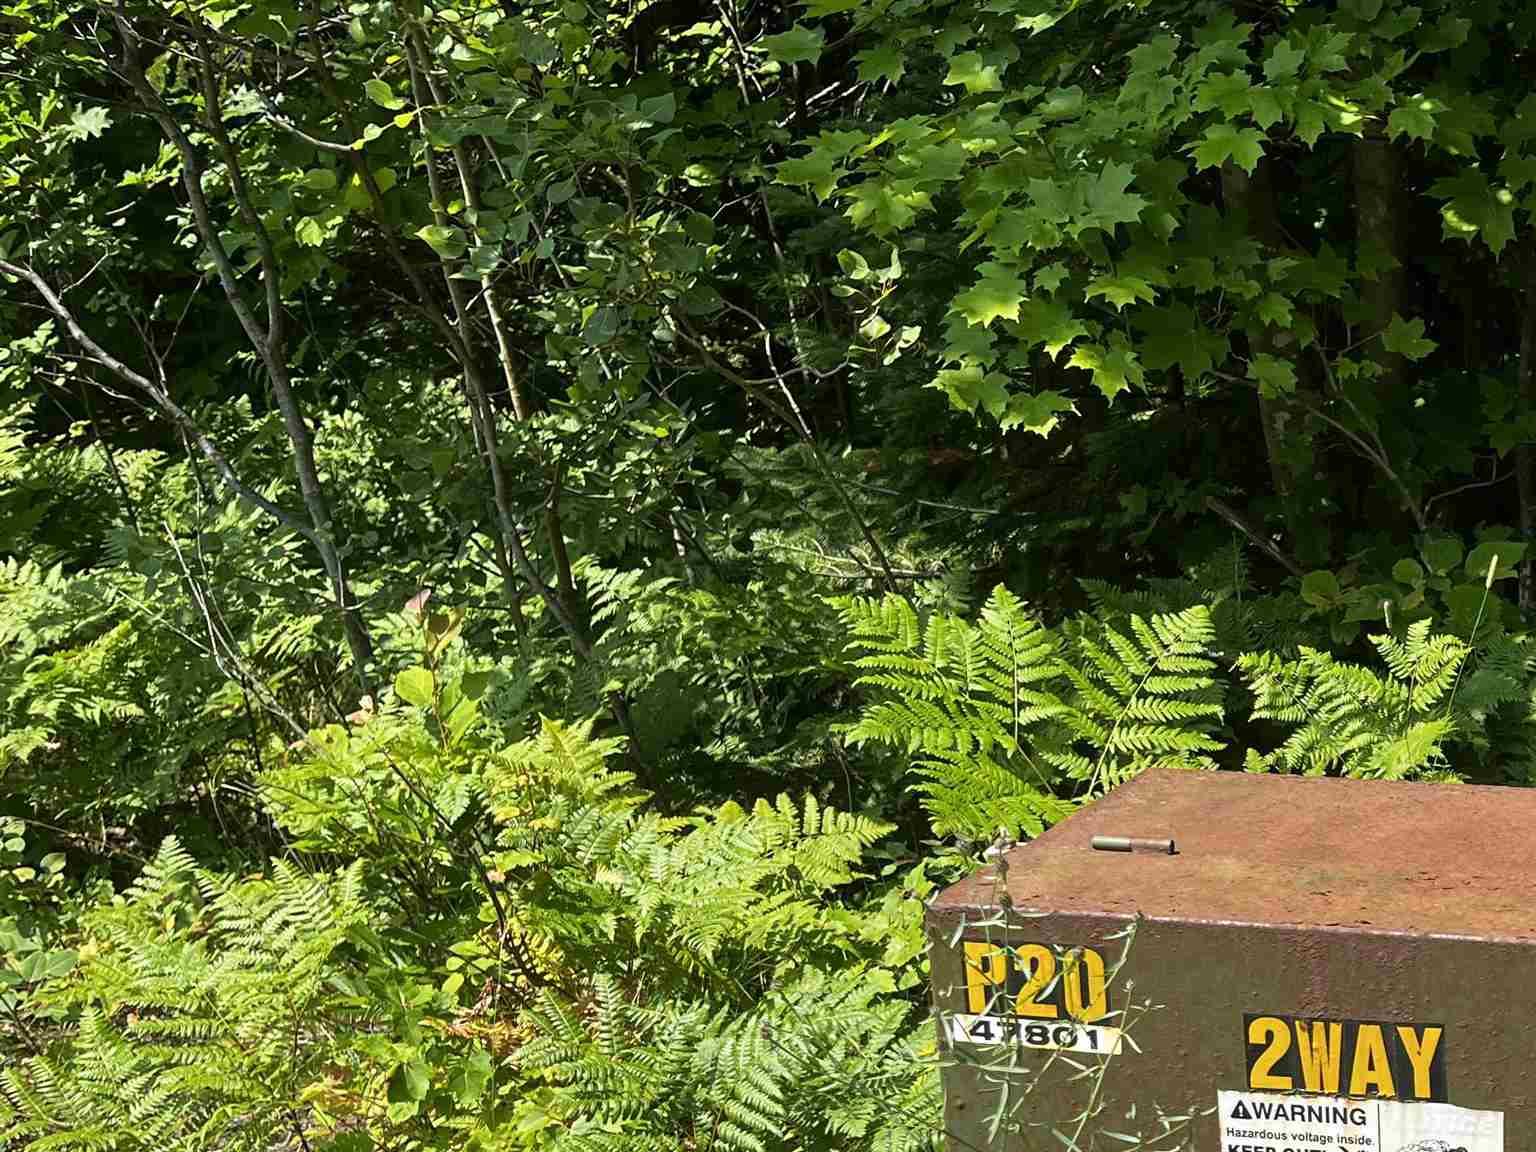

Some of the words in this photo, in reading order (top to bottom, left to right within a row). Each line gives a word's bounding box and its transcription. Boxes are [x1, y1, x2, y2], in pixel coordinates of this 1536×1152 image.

[963, 941, 1107, 1024] P20
[1248, 1016, 1443, 1098] 2WAY
[1226, 1127, 1288, 1141] Hazardous
[1291, 1130, 1334, 1145] voltage
[1337, 1134, 1375, 1146] inside.
[1251, 1102, 1367, 1126] WARNING
